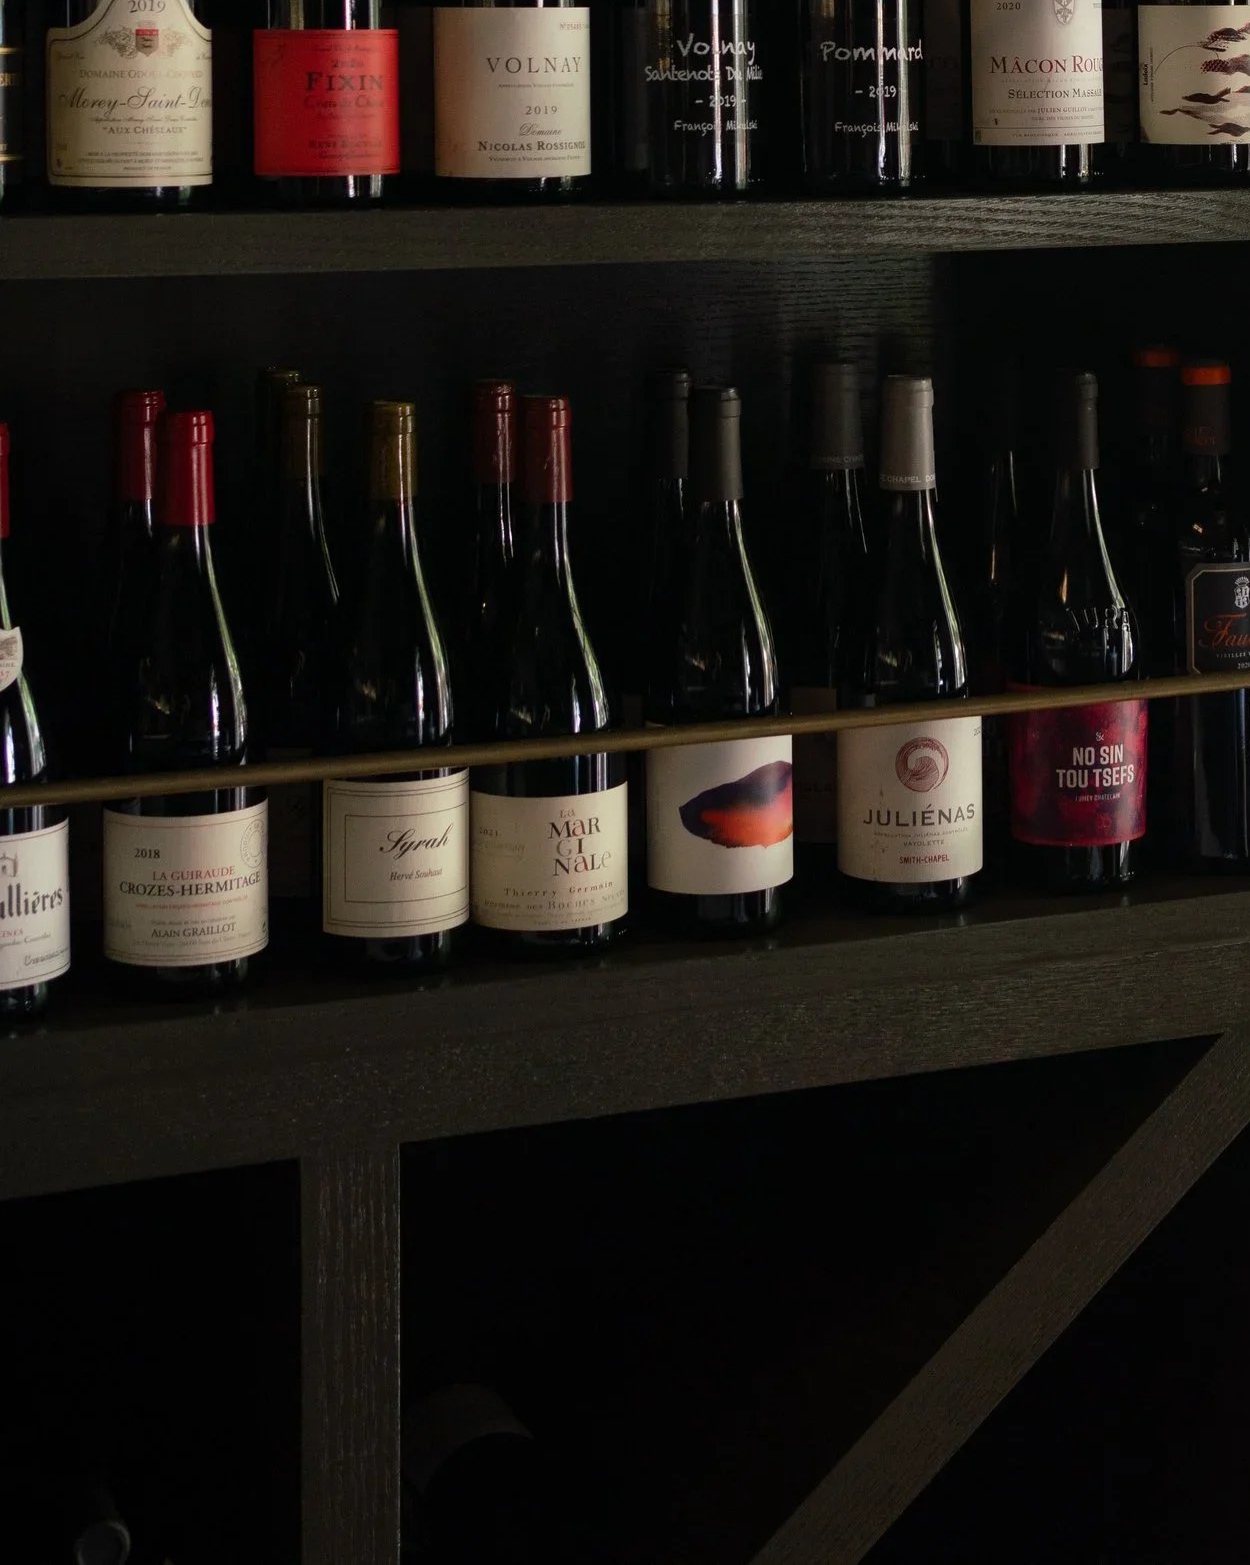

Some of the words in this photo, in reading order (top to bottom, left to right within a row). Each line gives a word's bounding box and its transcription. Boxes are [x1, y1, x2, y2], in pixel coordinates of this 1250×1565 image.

[128, 0, 166, 13] 2019
[996, 2, 1021, 11] 2020
[820, 39, 923, 62] Pommard
[486, 57, 581, 74] VOLNAY
[989, 55, 1067, 74] MÂCON
[79, 69, 126, 79] DOMAINE
[306, 71, 382, 91] FIXIN
[869, 85, 897, 98] 2019
[1008, 89, 1069, 99] SÉLECTION
[709, 95, 736, 107] 2019
[525, 105, 558, 114] 2019
[519, 123, 562, 136] Domaine
[834, 121, 881, 138] François
[478, 141, 533, 151] NICOLAS
[537, 140, 586, 151] ROSSIGNOL
[1072, 747, 1095, 766] NO
[1100, 743, 1124, 765] SIN
[1055, 768, 1089, 788] TOU
[1092, 763, 1135, 788] TSEFS
[863, 803, 976, 827] JULIÉNAS
[379, 823, 453, 860] Syrah
[556, 838, 584, 857] GI
[134, 848, 161, 859] 2018
[900, 853, 950, 864] SMITH-CHAPEL
[152, 871, 168, 881] LA
[170, 866, 236, 881] GUIRAUDE
[389, 872, 413, 881] Hervé
[119, 871, 261, 897] CROZES-HERMITAGE
[503, 888, 557, 898] Thierry
[569, 881, 613, 894] Germain
[151, 928, 180, 938] ALAIN
[182, 922, 236, 937] GRAILLOT
